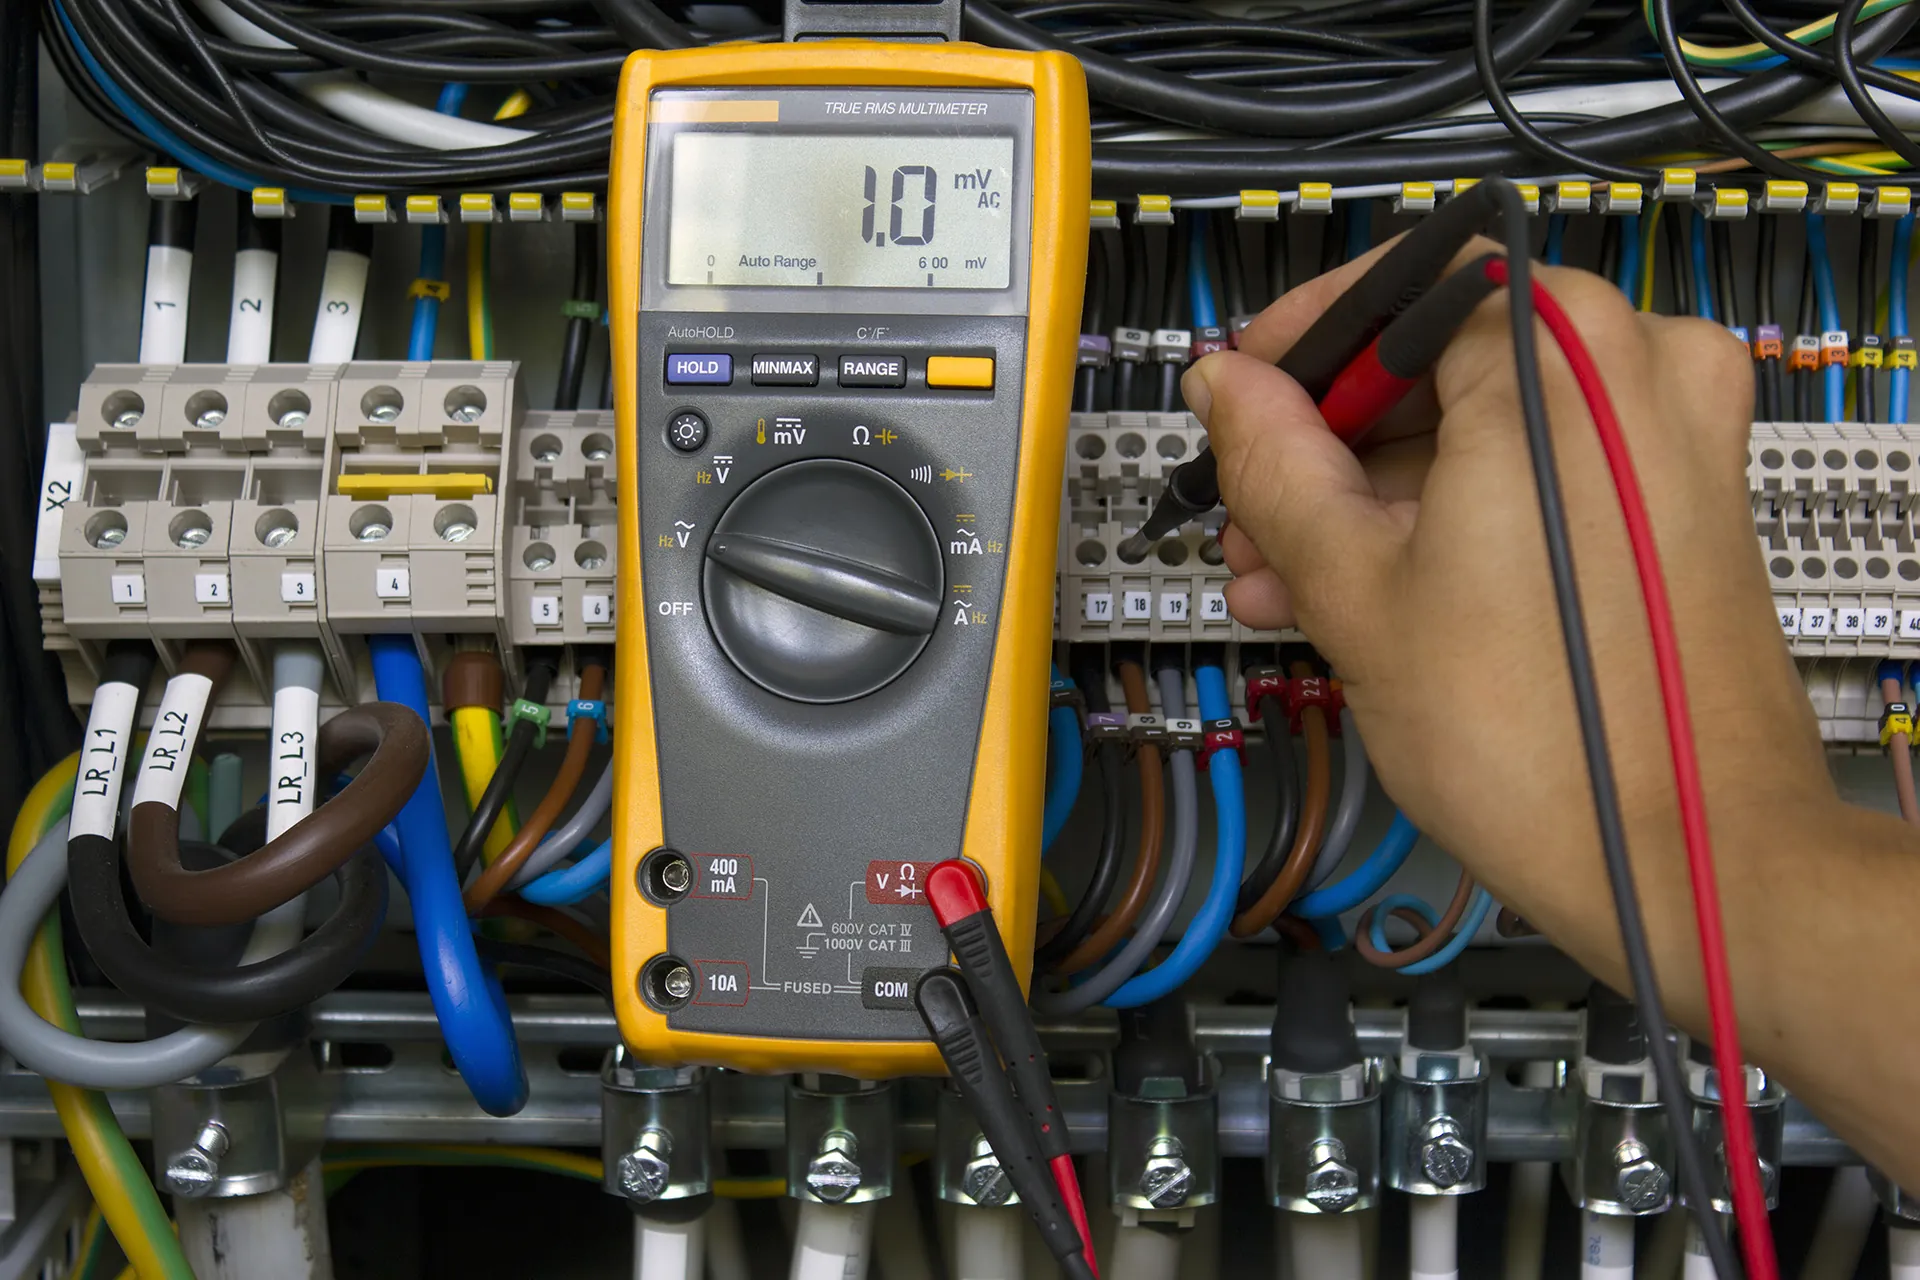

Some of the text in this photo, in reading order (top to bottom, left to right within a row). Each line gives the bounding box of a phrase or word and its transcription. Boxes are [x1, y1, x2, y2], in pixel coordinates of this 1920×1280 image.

[825, 102, 988, 115] TRUE RMS MULTIMETER
[861, 165, 992, 247] 1.0 mV
[978, 191, 1001, 209] AC
[707, 255, 715, 268] 0
[739, 254, 772, 268] Auto
[774, 255, 817, 270] Range
[965, 257, 987, 269] mV
[154, 299, 176, 311] 1
[240, 298, 262, 313] 2
[327, 300, 350, 315] 3
[668, 326, 734, 340] AutoHOLD
[676, 361, 719, 375] HOLD
[752, 361, 813, 375] MINMAX
[843, 362, 899, 376] RANGE
[774, 428, 806, 445] mV
[696, 467, 730, 484] Hz V
[46, 480, 72, 512] X2
[658, 531, 691, 548] Hz V
[950, 538, 1003, 555] mA Hz
[127, 584, 132, 596] 1
[211, 584, 218, 596] 2
[297, 583, 304, 595] 3
[391, 578, 398, 590] 4
[543, 604, 549, 616] 5
[594, 603, 600, 615] 6
[658, 602, 693, 616] OFF
[1095, 600, 1107, 613] 17
[1134, 598, 1146, 611] 18
[1170, 600, 1181, 613] 19
[1211, 600, 1223, 612] 20
[954, 609, 987, 626] A Hz
[1782, 615, 1794, 627] 36
[1811, 615, 1824, 628] 37
[1846, 615, 1859, 628] 38
[1874, 615, 1887, 628] 39
[1260, 668, 1278, 687] 21
[1303, 678, 1321, 696] 22
[522, 704, 539, 715] 5
[577, 702, 594, 711] 6
[1099, 715, 1119, 732] 17
[1216, 719, 1233, 741] 20
[1177, 721, 1193, 741] 19
[148, 711, 188, 772] LR_L2
[82, 728, 117, 797] LR_L1
[277, 731, 308, 804] LR_L3
[709, 858, 738, 876] 400
[710, 877, 736, 894] mA
[876, 873, 889, 890] V
[831, 923, 864, 936] 600V
[868, 923, 897, 936] CAT
[824, 938, 864, 951] 1000V
[868, 939, 897, 952] CAT
[708, 974, 738, 992] 10A
[784, 981, 832, 994] FUSED
[875, 981, 908, 998] COM
